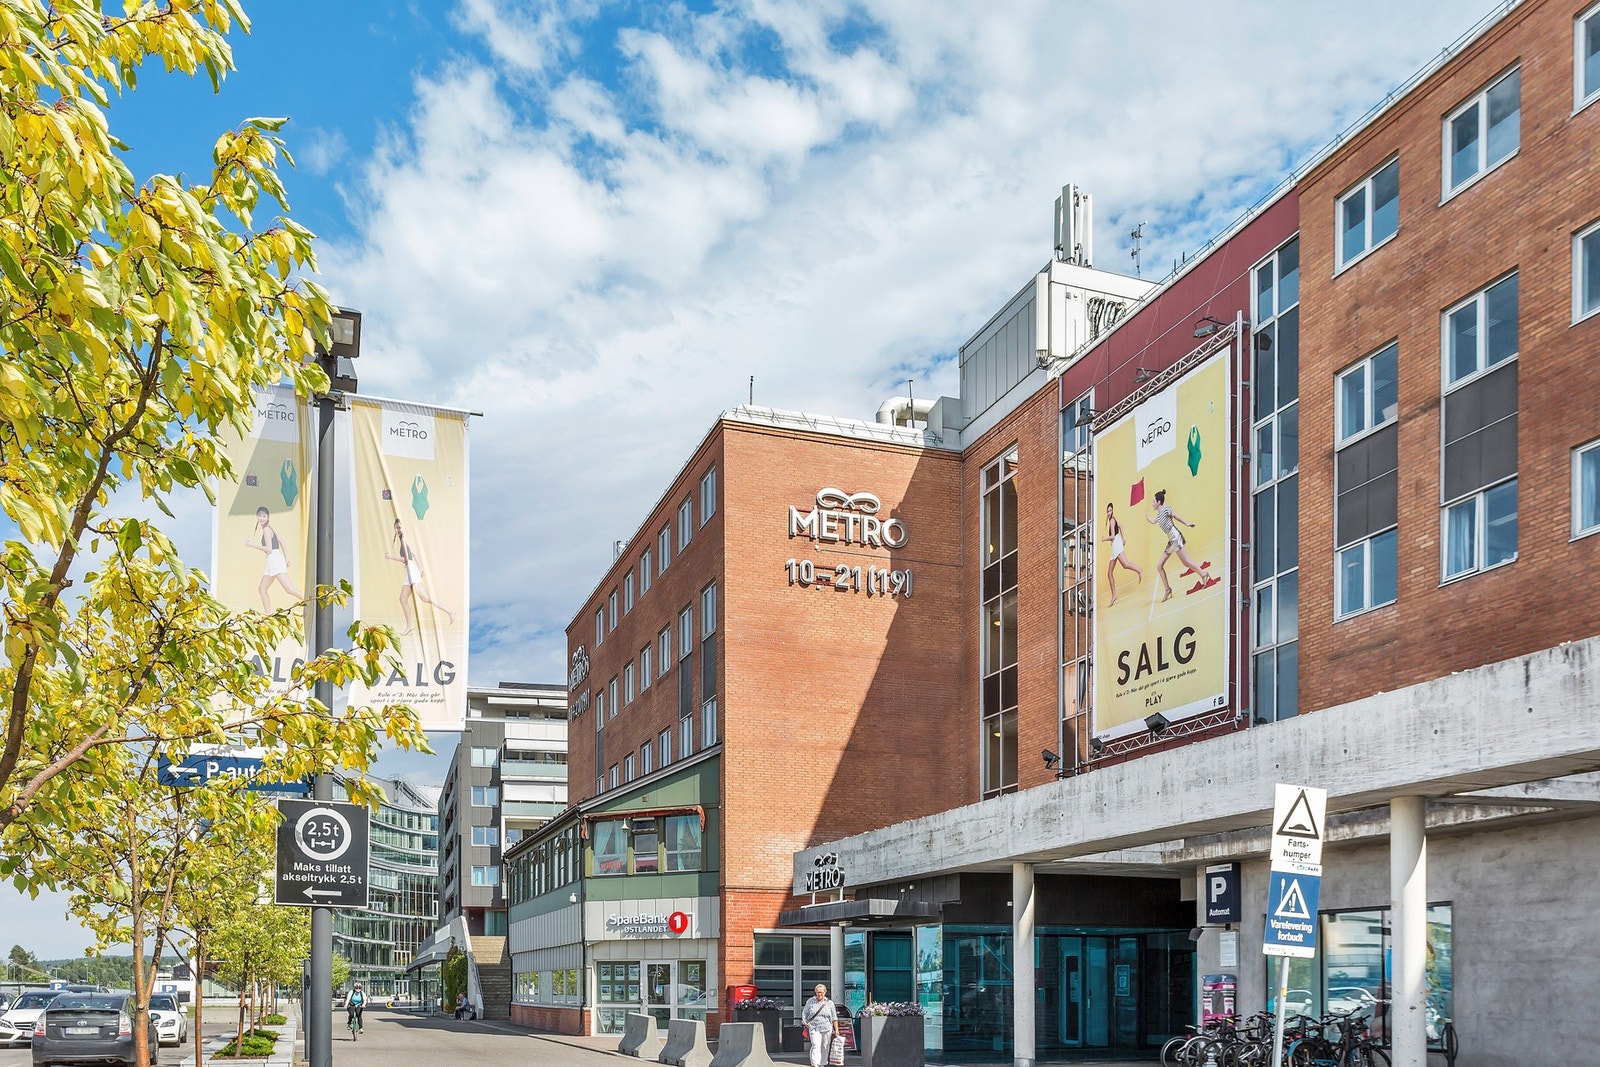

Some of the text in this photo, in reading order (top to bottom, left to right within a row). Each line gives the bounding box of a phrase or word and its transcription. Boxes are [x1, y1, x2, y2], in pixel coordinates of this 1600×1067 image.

[257, 408, 295, 422] METRO
[389, 426, 428, 440] METRO
[1141, 421, 1172, 448] METRO
[788, 504, 909, 549] METRO
[1116, 626, 1197, 686] SALG
[1145, 693, 1163, 708] PLAY
[206, 761, 303, 785] P-auto
[1287, 839, 1310, 849] Farts-
[1282, 849, 1311, 860] humper
[293, 862, 352, 874] Maks tillatt
[282, 872, 337, 884] akseltrykk
[805, 867, 845, 891] METRO
[1211, 876, 1227, 903] P
[1209, 907, 1230, 917] Automat
[609, 912, 682, 929] SpareBank 1
[1270, 919, 1313, 934] Varelevering
[624, 925, 668, 933] ØSTLANDET
[1277, 930, 1304, 943] forbudt
